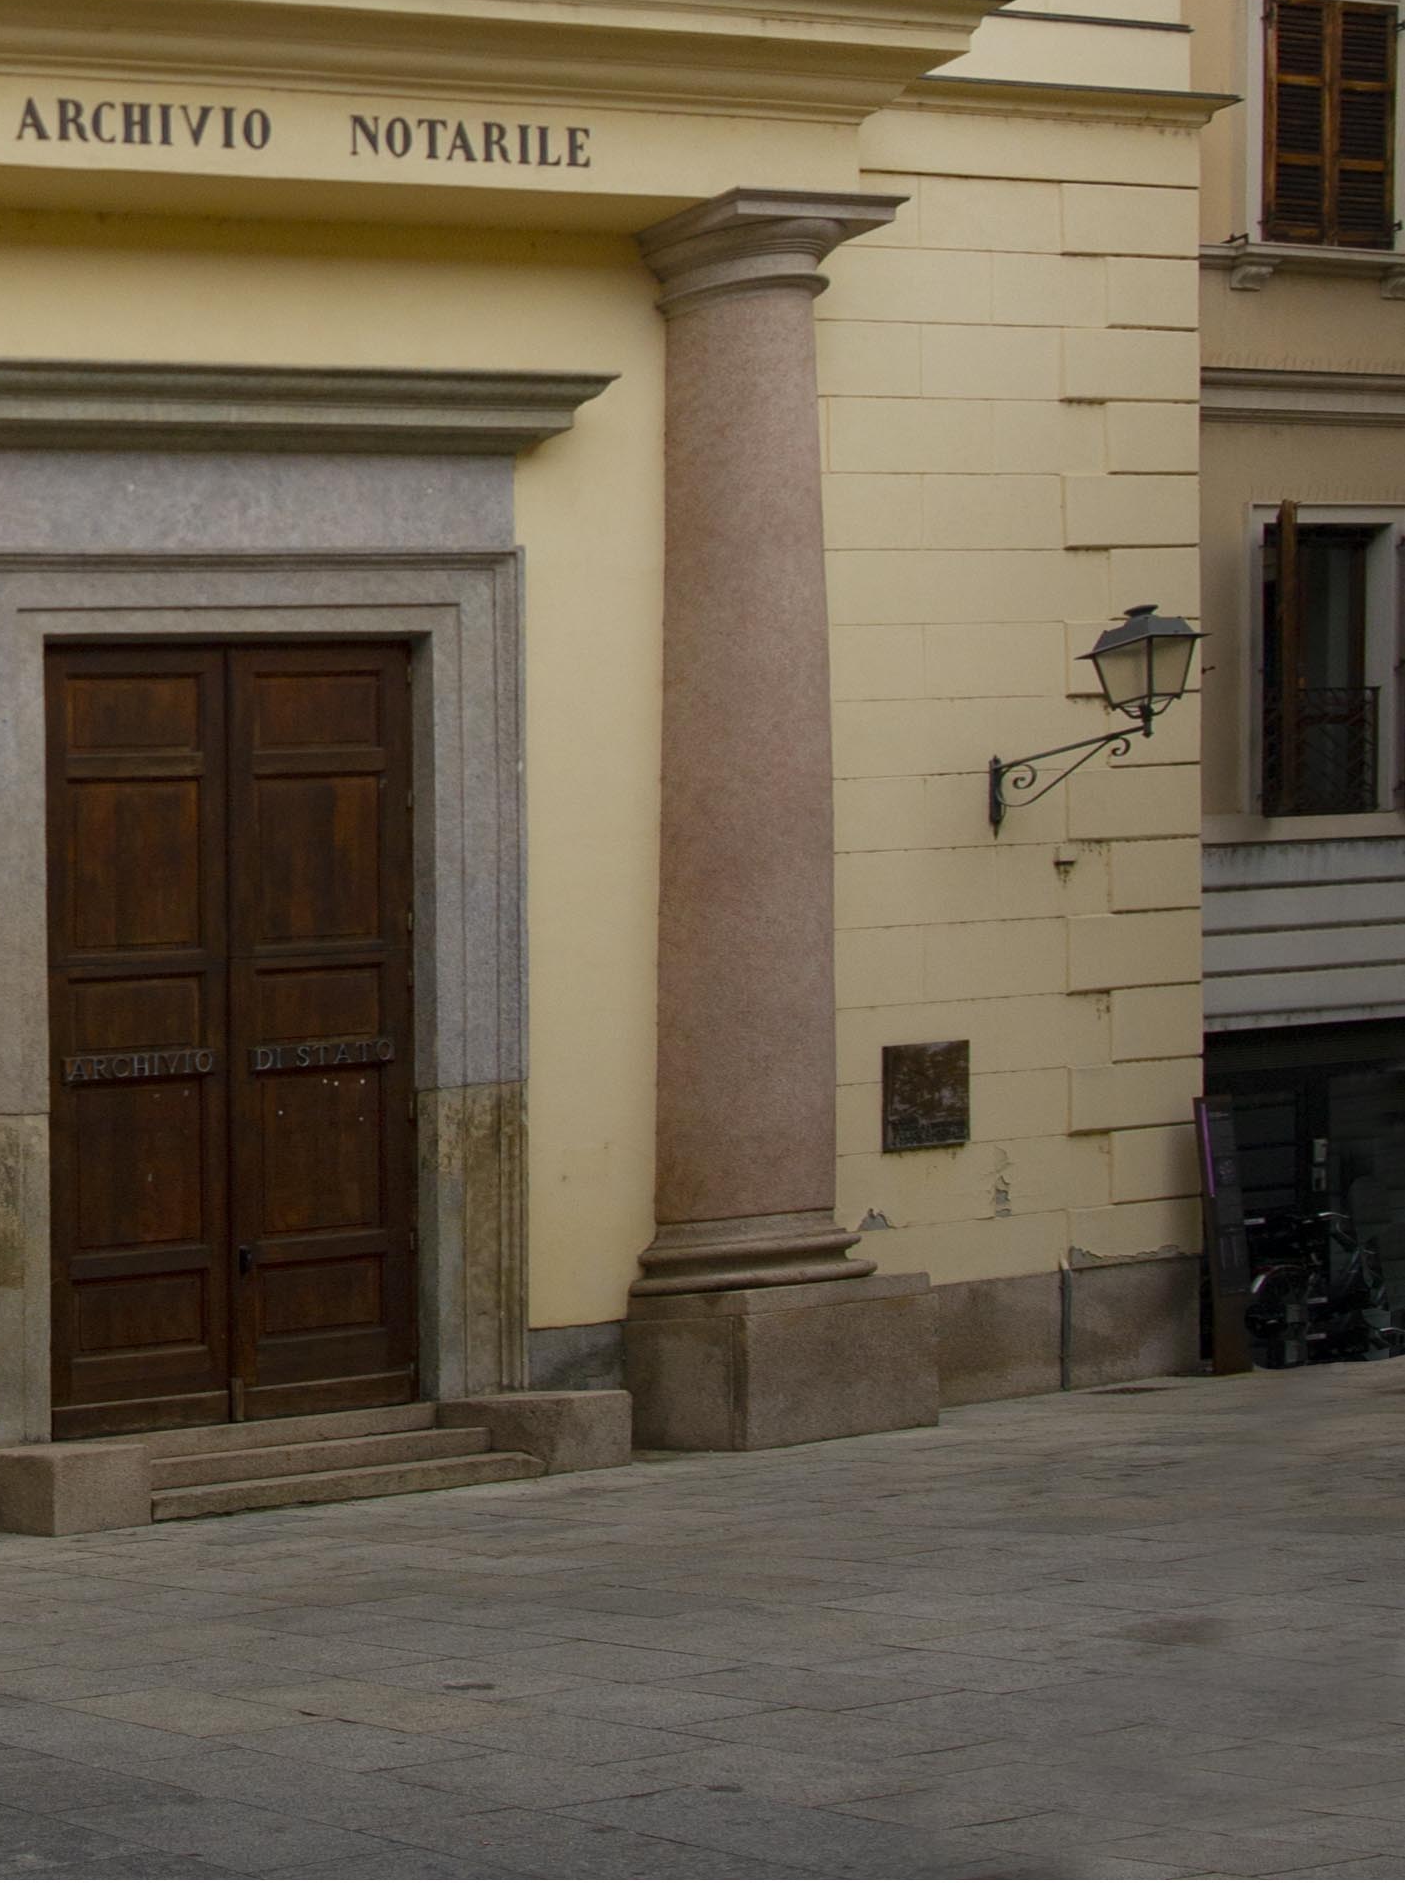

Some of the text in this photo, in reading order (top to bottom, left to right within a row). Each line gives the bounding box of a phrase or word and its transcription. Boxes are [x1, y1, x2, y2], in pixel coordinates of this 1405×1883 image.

[15, 96, 592, 168] ARCHIVIO NOTARILE
[67, 1039, 395, 1081] ARCHIVIO DI STATO
